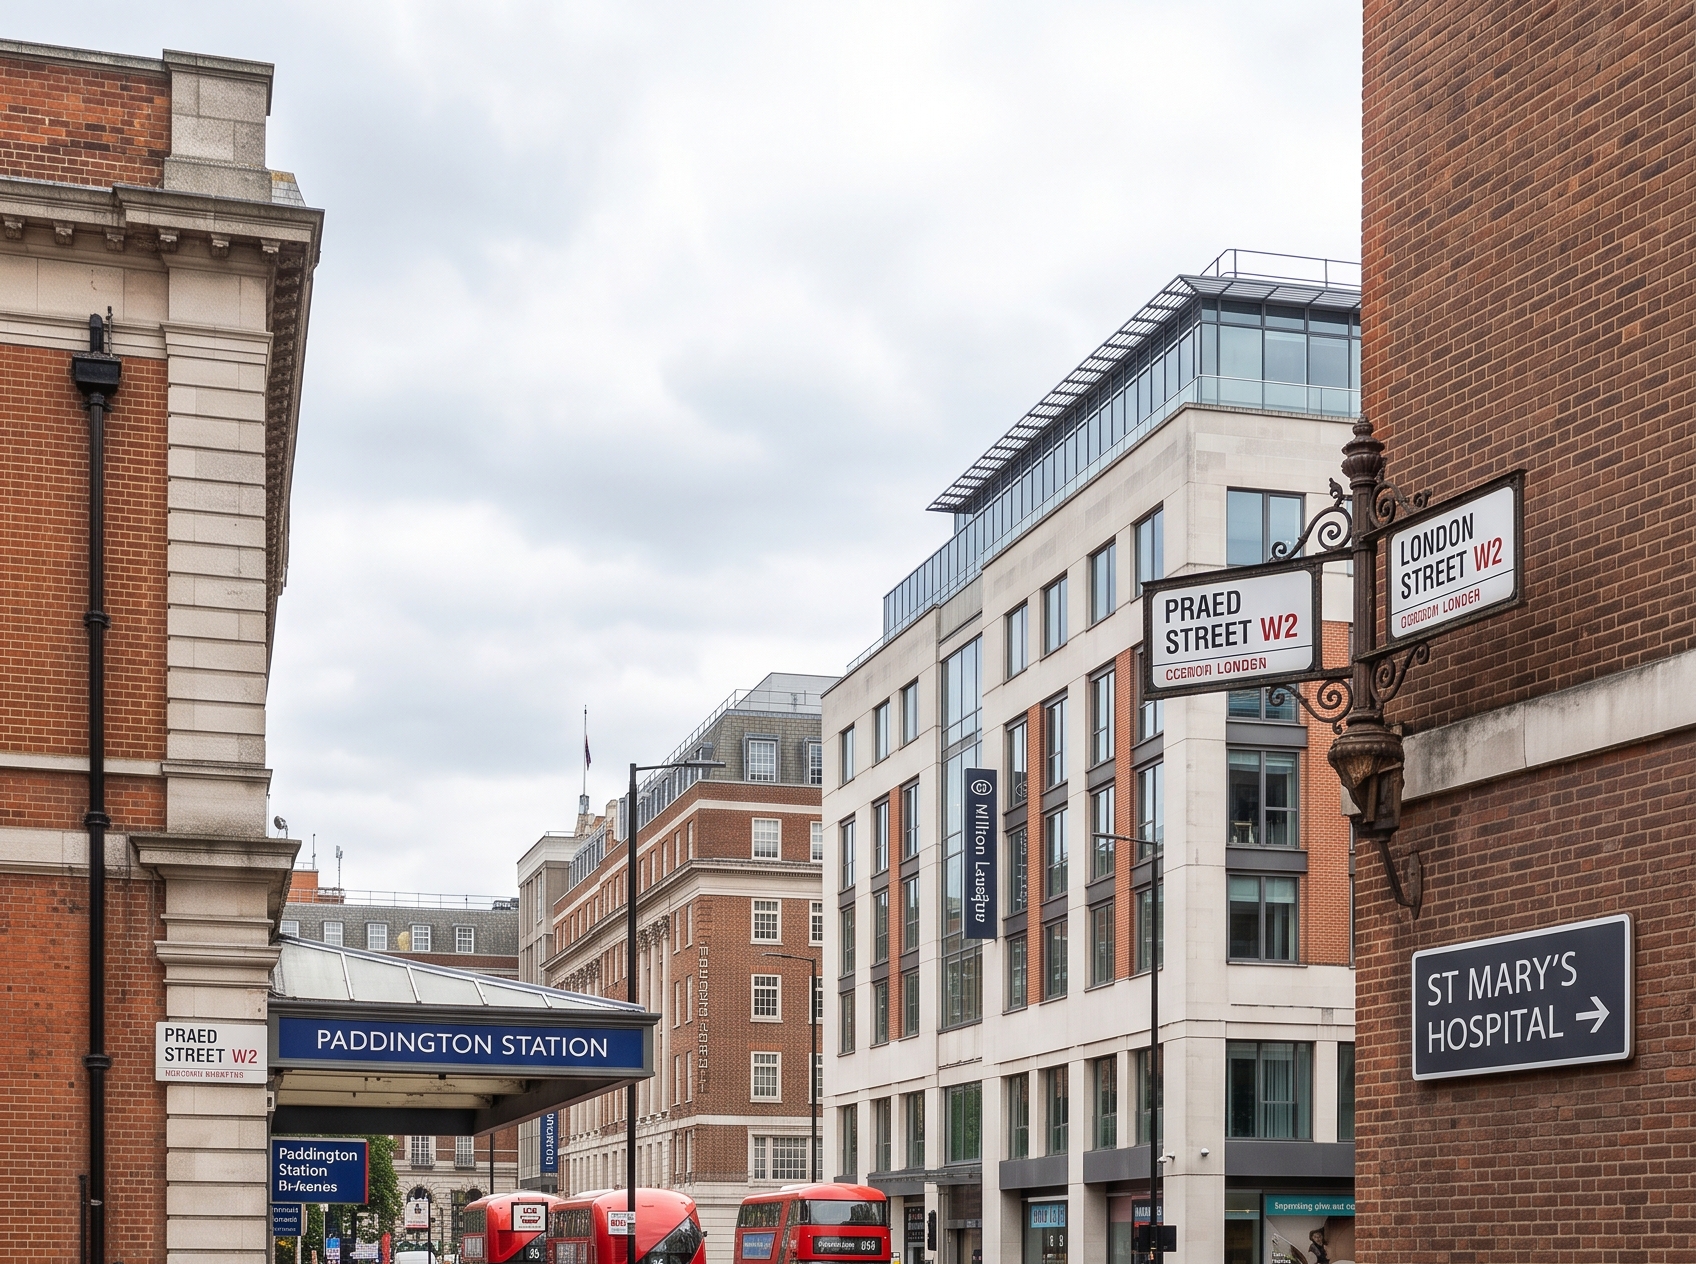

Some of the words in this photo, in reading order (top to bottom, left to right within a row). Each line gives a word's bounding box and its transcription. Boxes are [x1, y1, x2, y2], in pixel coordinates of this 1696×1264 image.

[1400, 512, 1474, 567] LONDON
[1401, 550, 1468, 600] STREET
[1473, 537, 1503, 572] W2
[1165, 590, 1241, 624] PRAED
[1165, 619, 1252, 655] STREET
[1260, 613, 1298, 641] W2
[1427, 970, 1459, 1006] ST
[1468, 951, 1578, 1001] MARY'S
[164, 1028, 217, 1044] PRAED
[317, 1029, 492, 1055] PADDINGTON
[501, 1035, 608, 1058] STATION
[1428, 1004, 1564, 1054] HOSPITAL
[164, 1047, 226, 1063] STREET
[232, 1049, 258, 1064] W2
[279, 1147, 358, 1164] Paddington
[279, 1163, 328, 1177] Station
